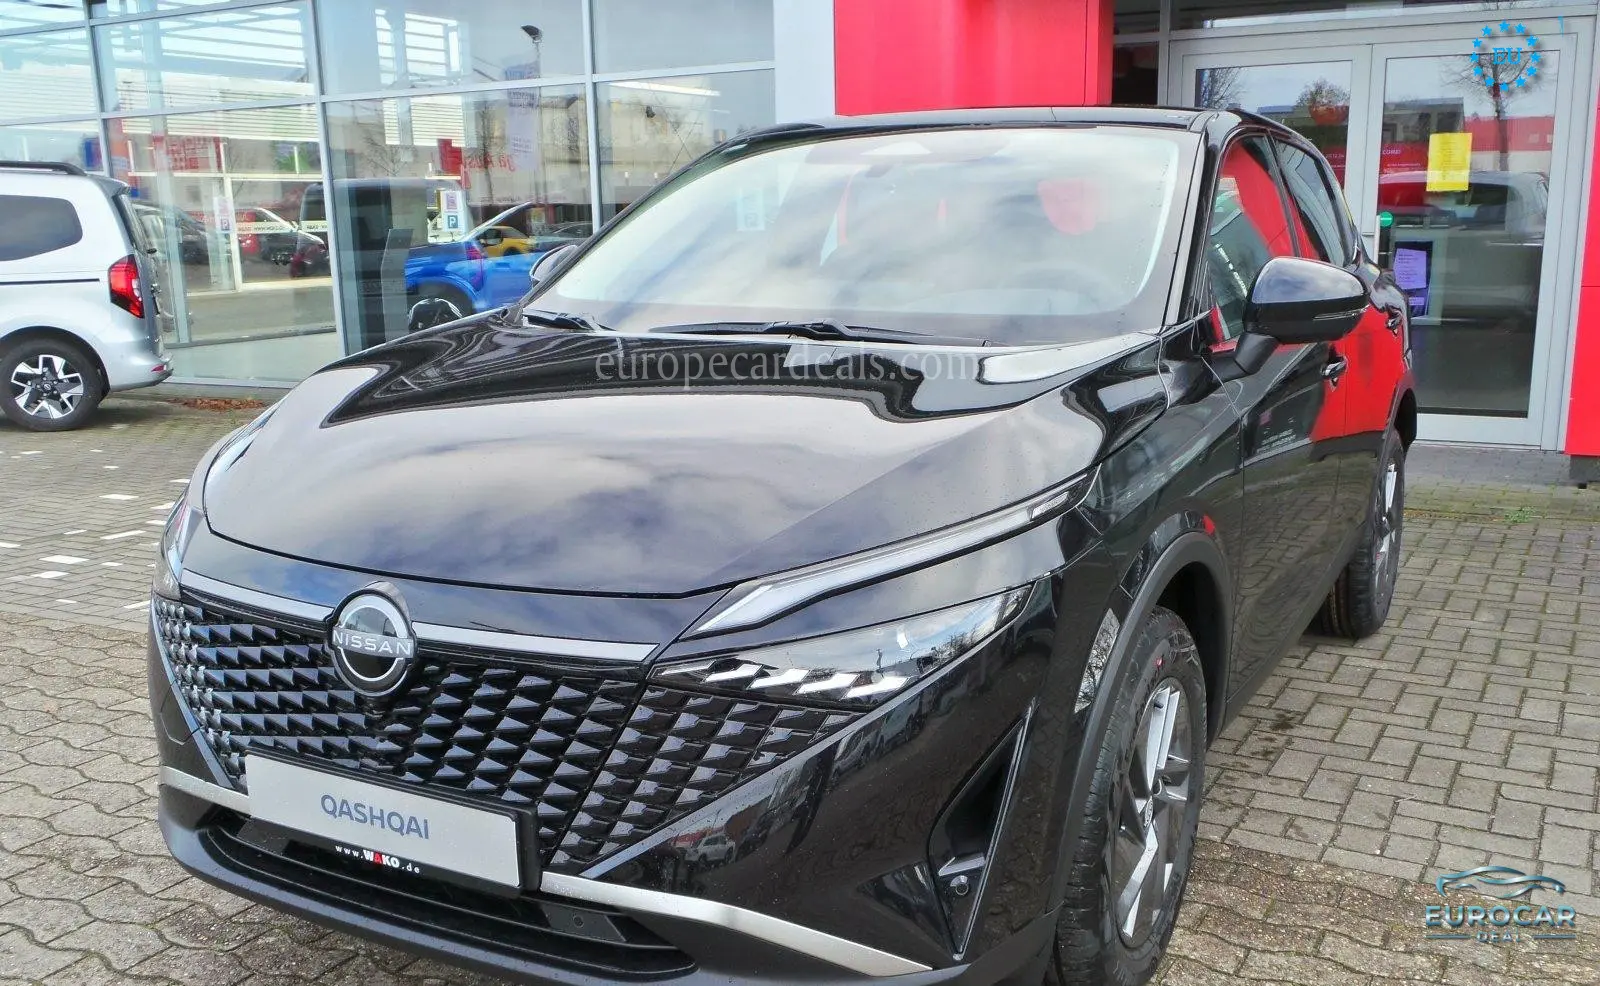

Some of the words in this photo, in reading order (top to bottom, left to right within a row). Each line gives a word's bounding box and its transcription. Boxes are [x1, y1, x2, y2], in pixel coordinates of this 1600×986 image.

[449, 215, 457, 228] P
[333, 629, 411, 655] NISSAN
[320, 794, 429, 840] QASHQAI
[335, 845, 420, 873] www.WAKO.de
